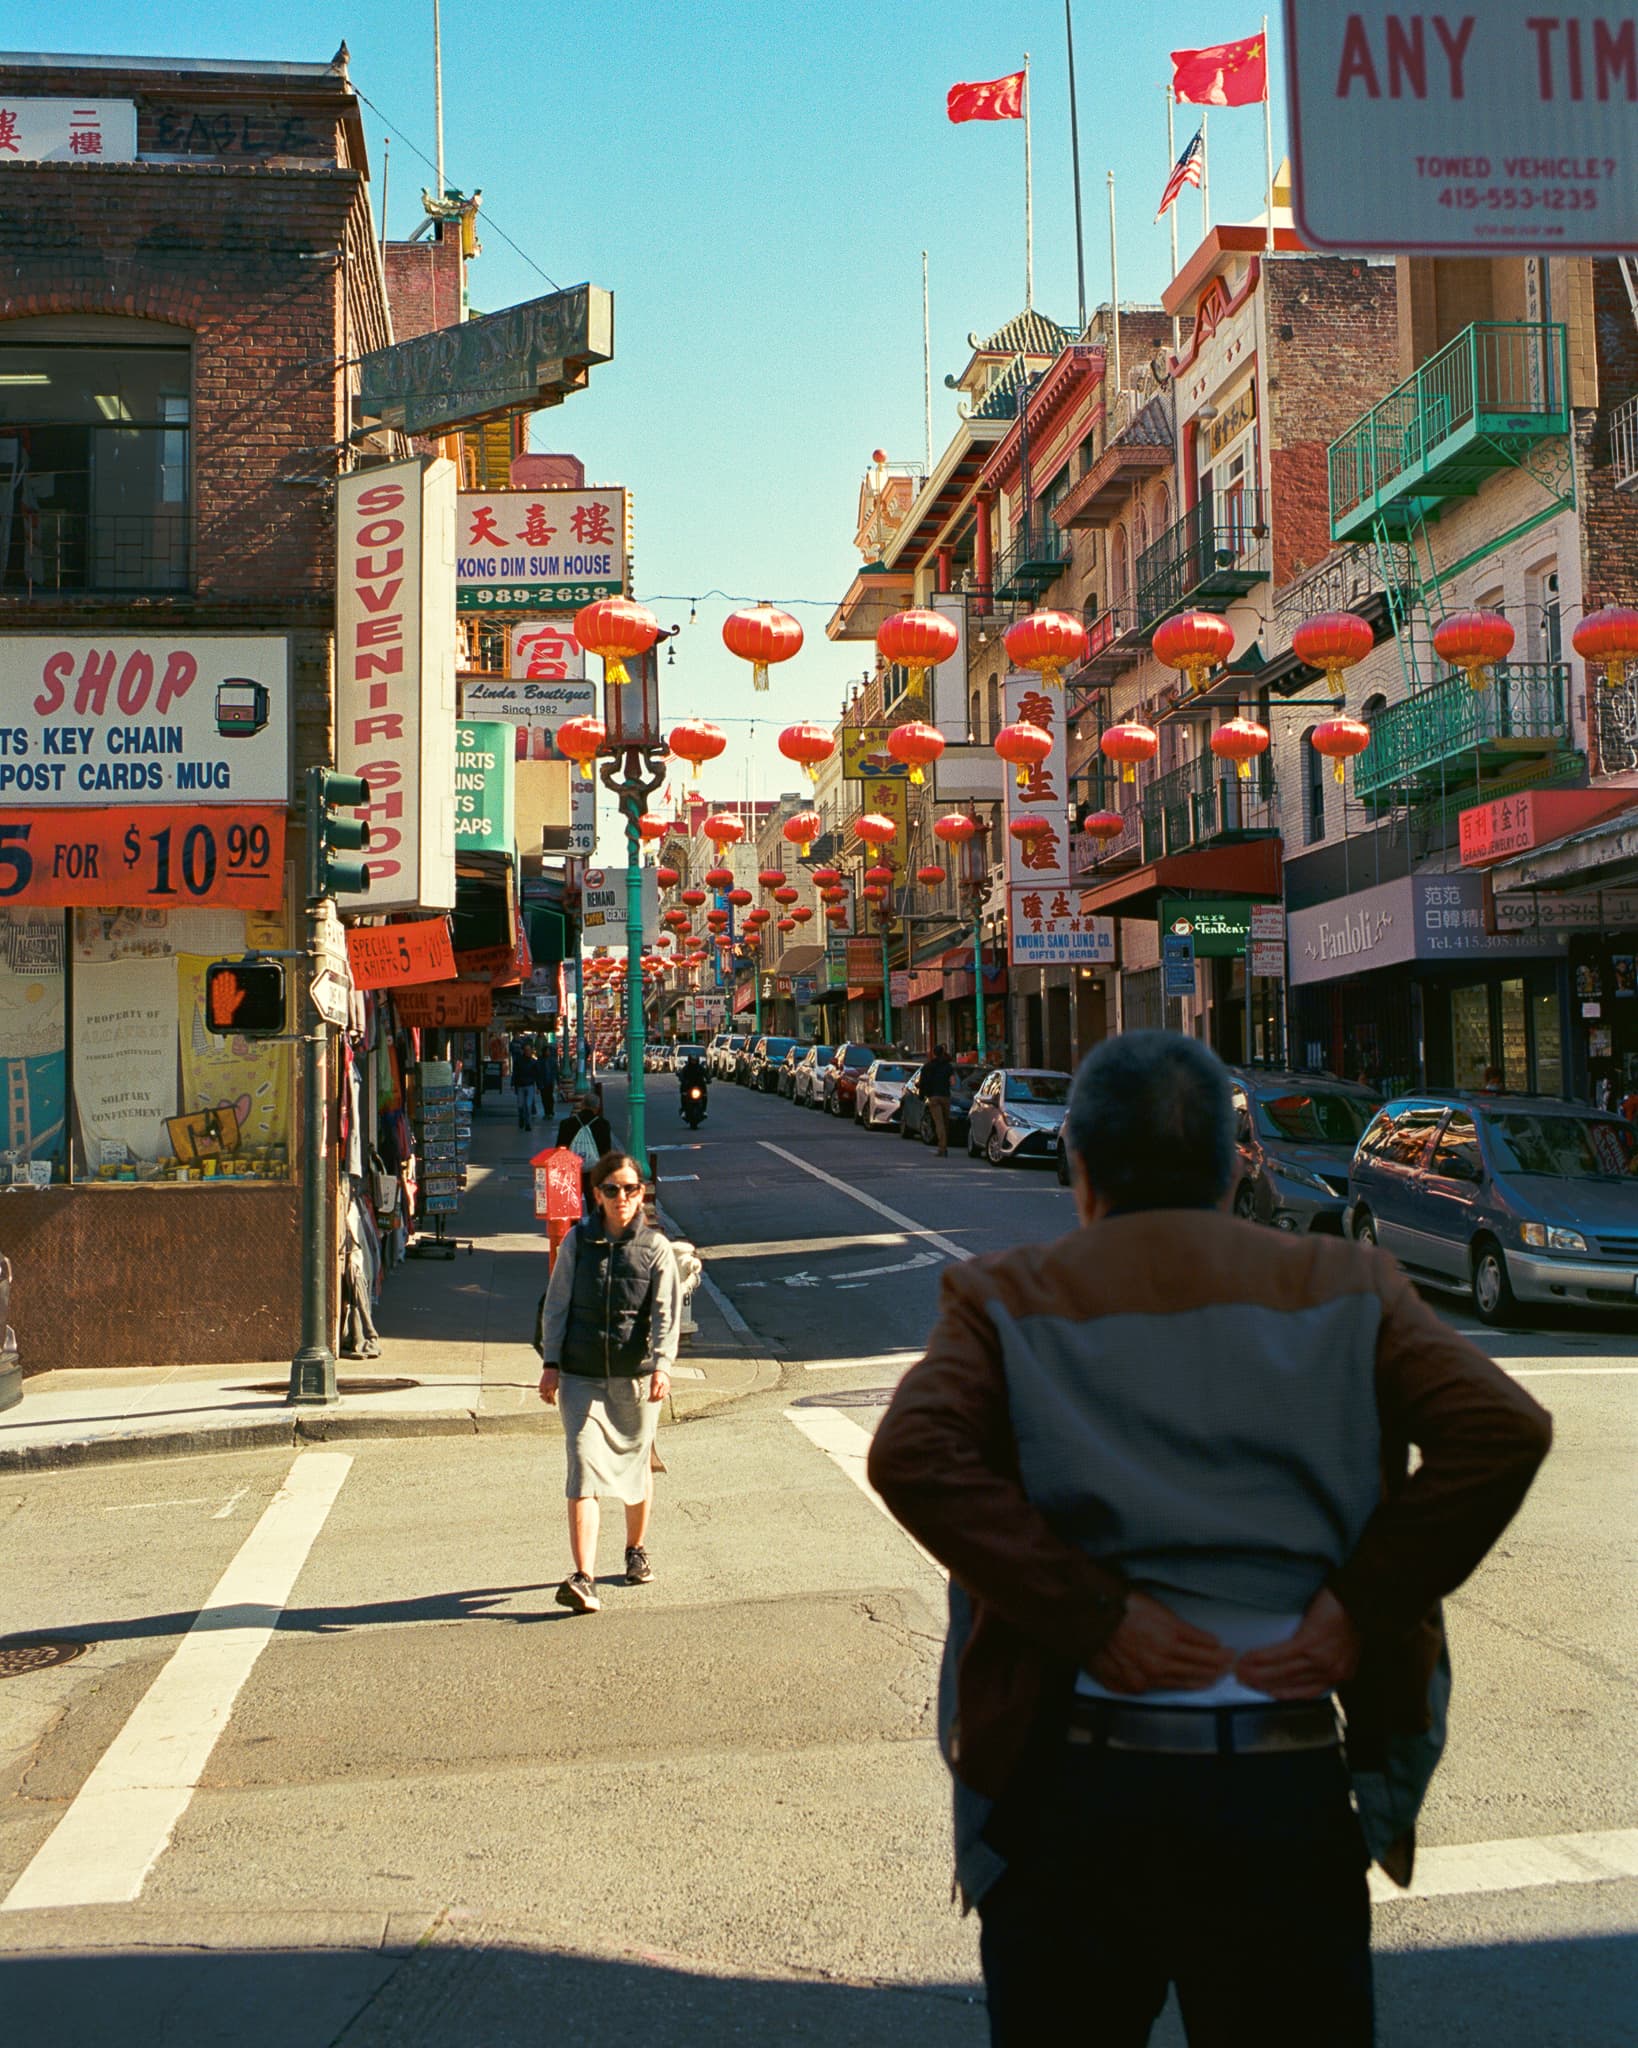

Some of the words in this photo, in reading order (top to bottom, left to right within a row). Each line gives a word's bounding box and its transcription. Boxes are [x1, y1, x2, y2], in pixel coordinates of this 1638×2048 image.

[1335, 14, 1475, 99] ANY
[1415, 156, 1491, 179] TOWED
[1503, 156, 1617, 180] VEHICLE?
[1437, 187, 1599, 211] 415-553-1235
[457, 557, 496, 577] KONG
[500, 556, 526, 577] DIM
[529, 555, 559, 576] SUM
[564, 554, 611, 575] HOUSE
[355, 483, 405, 746] SOUVENIR
[33, 648, 198, 717] SHOP
[468, 684, 518, 699] Linda
[523, 684, 592, 704] Boutique
[501, 704, 531, 714] Since
[534, 704, 558, 714] 1982
[43, 726, 94, 755] KEY
[106, 726, 183, 754] CHAIN
[0, 763, 66, 791] POST
[78, 762, 163, 790] CARDS
[176, 761, 230, 789] MUG
[455, 773, 485, 790] INS
[52, 844, 99, 879] FOR
[1425, 910, 1485, 929] 日韓精
[353, 935, 393, 958] SPECIAL
[1319, 910, 1374, 962] Fanloli
[398, 936, 411, 973] 5
[354, 957, 400, 980] T-SHIRTS
[87, 1009, 142, 1024] PROPERTY
[146, 1010, 160, 1019] OF
[101, 1091, 152, 1105] SOLITARY
[91, 1107, 162, 1122] CONFINEMENT
